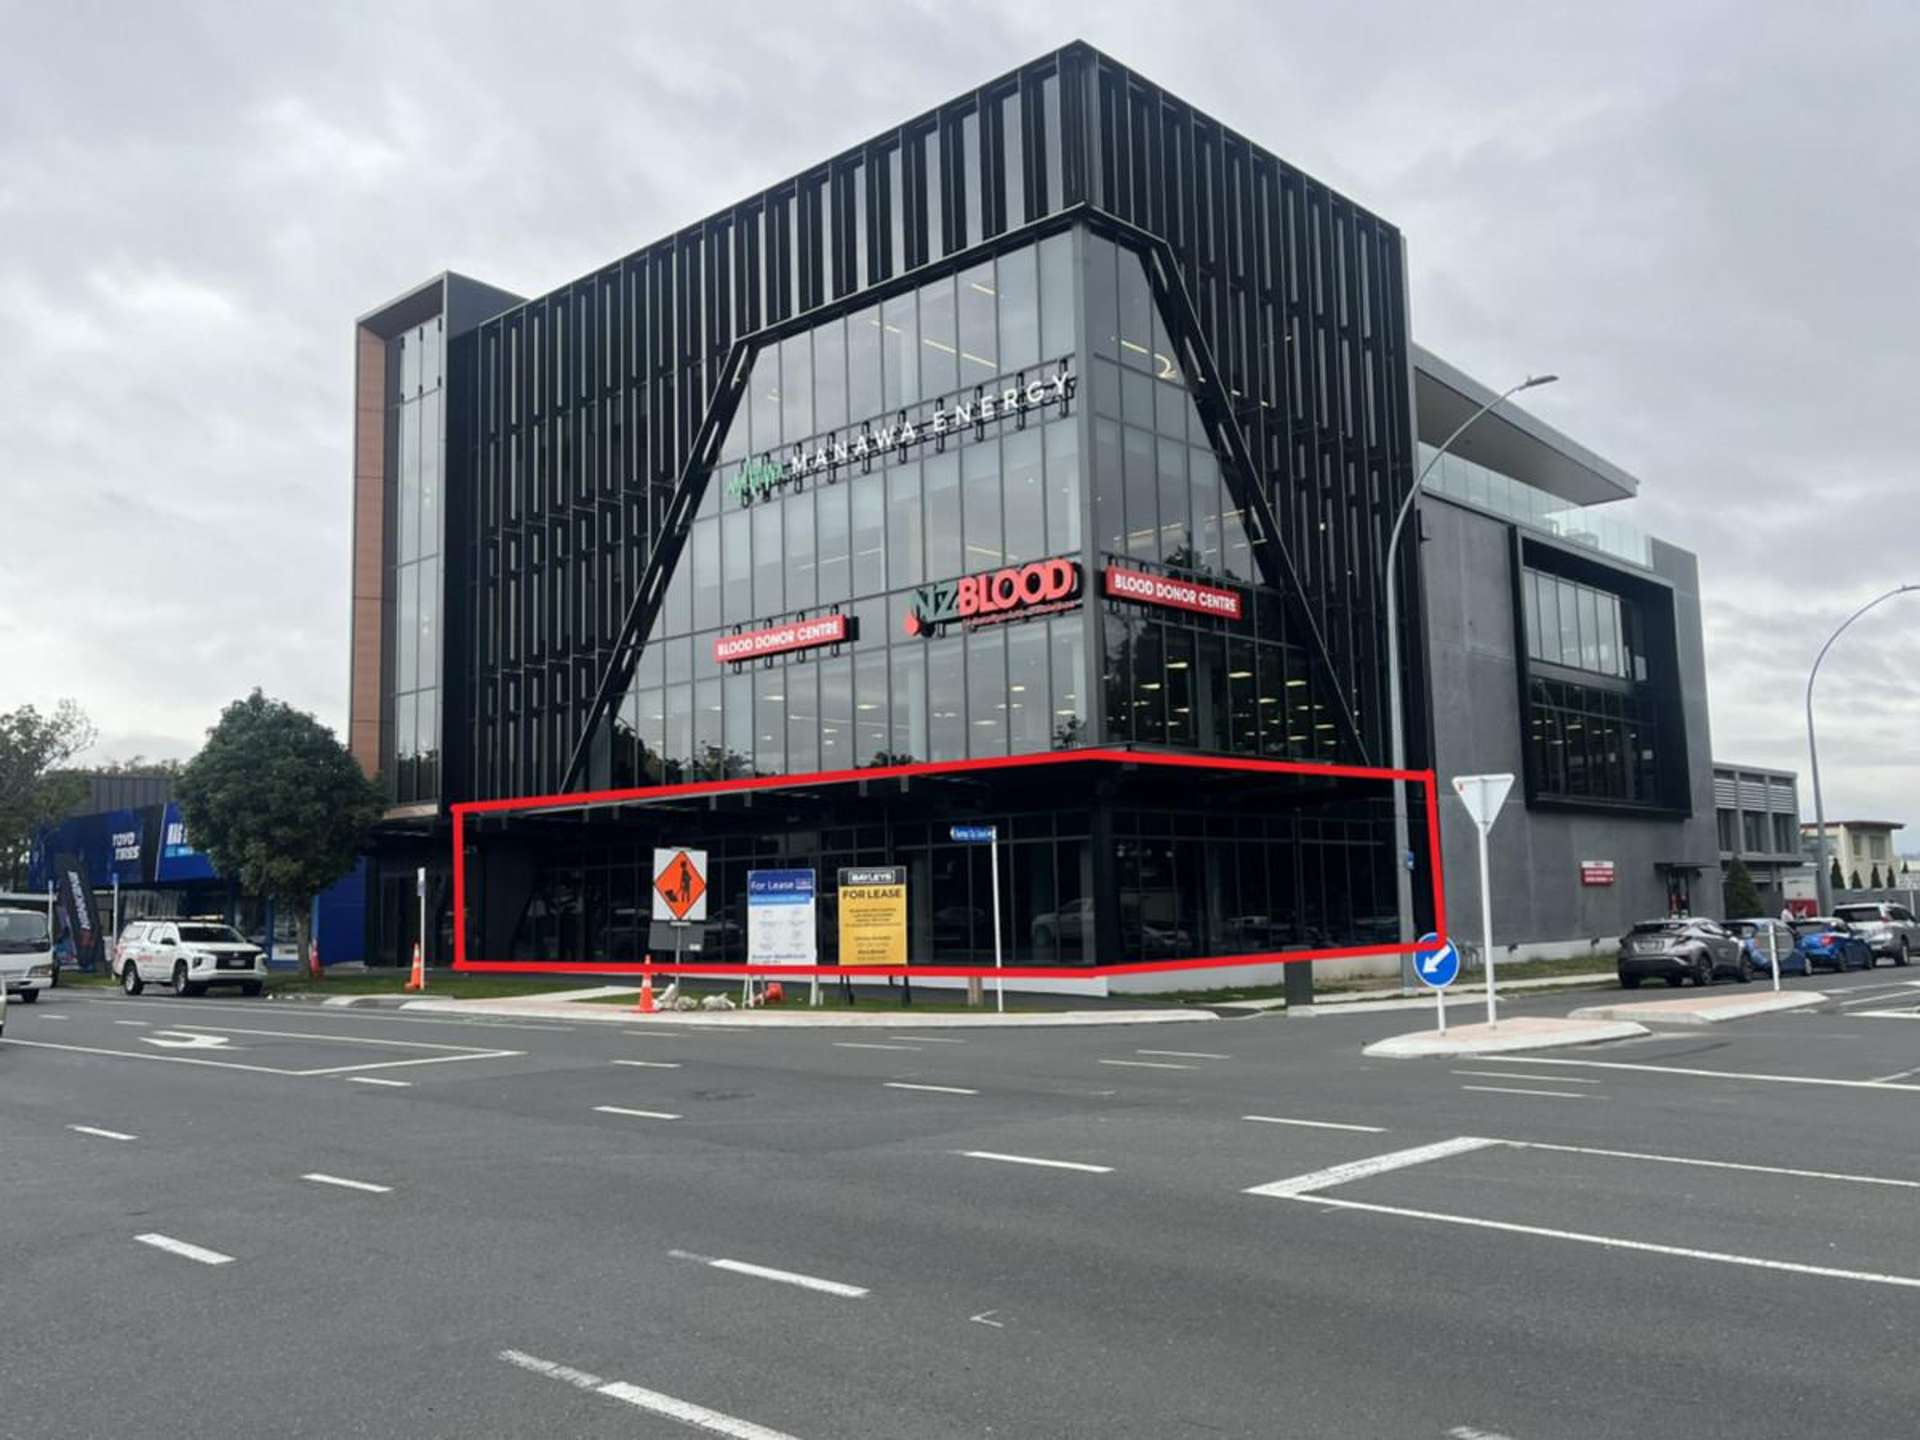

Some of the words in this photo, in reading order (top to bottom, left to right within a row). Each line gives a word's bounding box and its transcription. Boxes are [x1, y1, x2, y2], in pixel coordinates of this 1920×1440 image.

[791, 421, 916, 474] MANAWA
[933, 371, 1069, 432] ENERGY
[1114, 573, 1153, 596] BLOOD
[1156, 583, 1196, 604] DONOR
[1199, 592, 1236, 612] CENTRE
[717, 639, 753, 656] BLOOD
[755, 629, 795, 649] DONOR
[797, 621, 839, 641] CENTRE
[751, 881, 766, 891] For
[768, 881, 794, 890] Lease
[842, 888, 866, 900] FOR
[867, 887, 902, 899] LEASE
